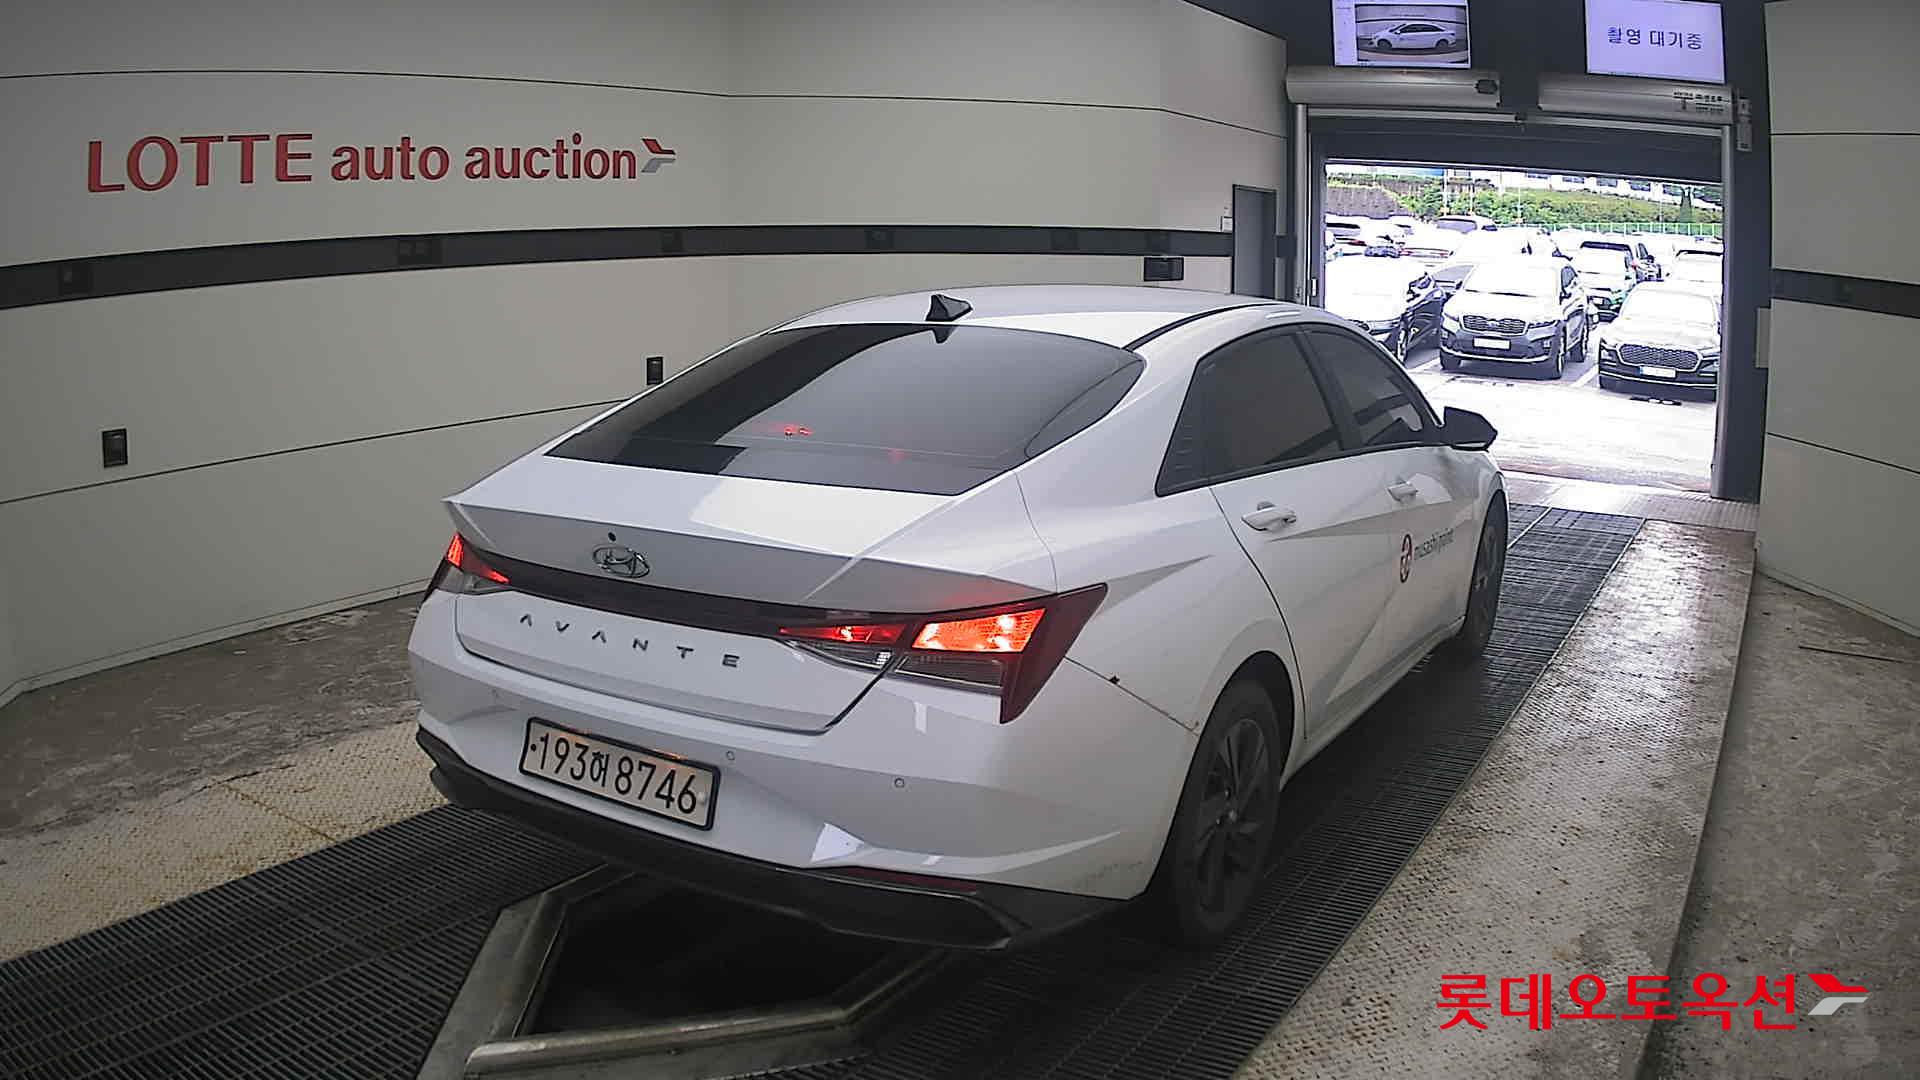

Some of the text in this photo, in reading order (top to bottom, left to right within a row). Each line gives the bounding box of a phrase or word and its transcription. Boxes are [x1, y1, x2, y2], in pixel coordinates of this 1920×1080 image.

[1649, 30, 1702, 50] 대기중
[88, 133, 638, 192] LOTTE auto auction
[519, 613, 740, 668] AVANTE
